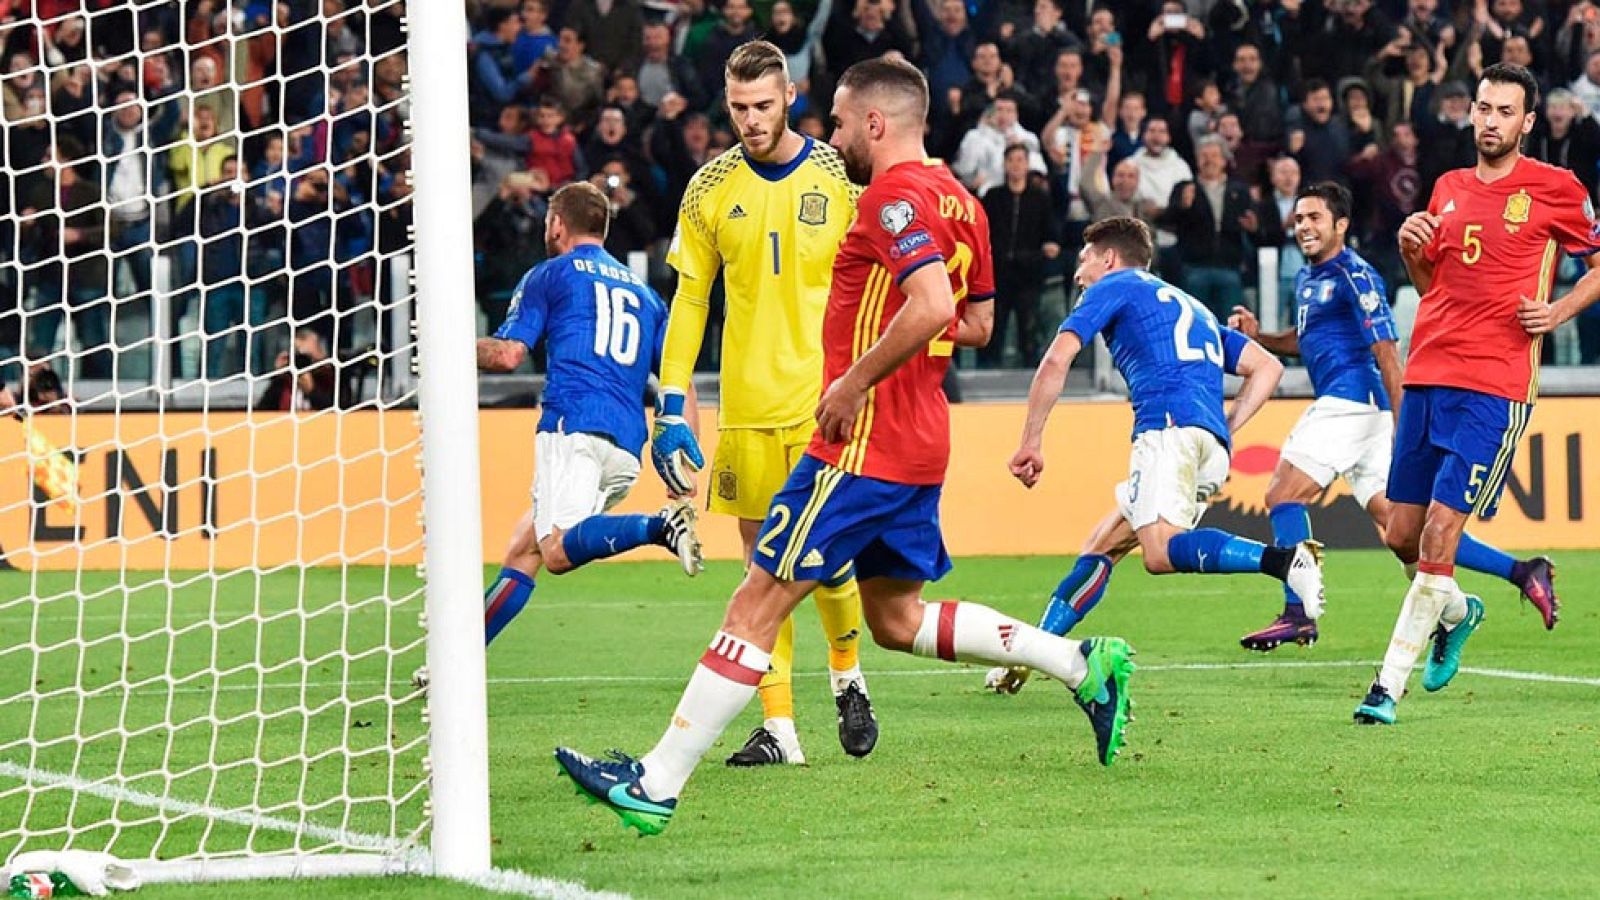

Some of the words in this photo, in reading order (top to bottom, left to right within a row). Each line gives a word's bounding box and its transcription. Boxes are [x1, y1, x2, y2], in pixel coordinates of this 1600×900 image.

[769, 232, 780, 275] 1
[1462, 225, 1482, 265] 5
[573, 259, 597, 274] DE
[594, 281, 640, 366] 16
[1464, 463, 1487, 504] 5
[757, 504, 791, 558] 2
